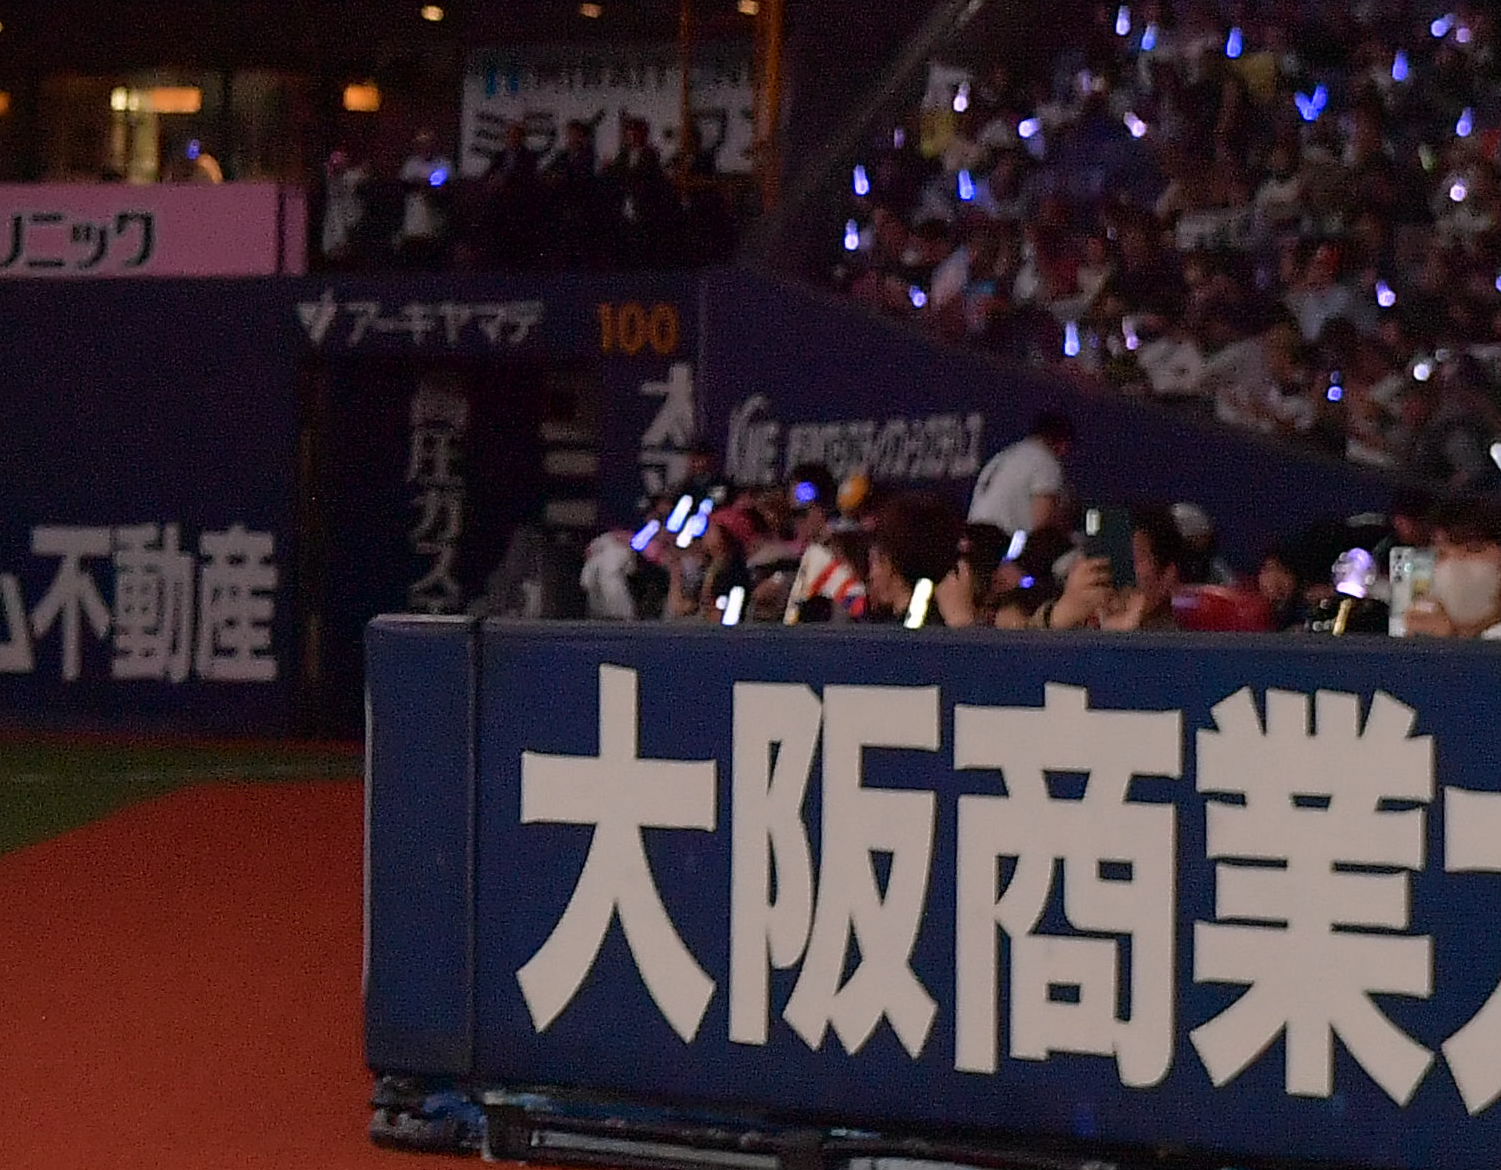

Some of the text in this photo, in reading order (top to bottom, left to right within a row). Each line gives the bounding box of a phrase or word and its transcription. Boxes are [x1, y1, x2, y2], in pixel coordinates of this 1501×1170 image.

[597, 301, 680, 357] 100
[515, 663, 1501, 1114] 大阪商業
